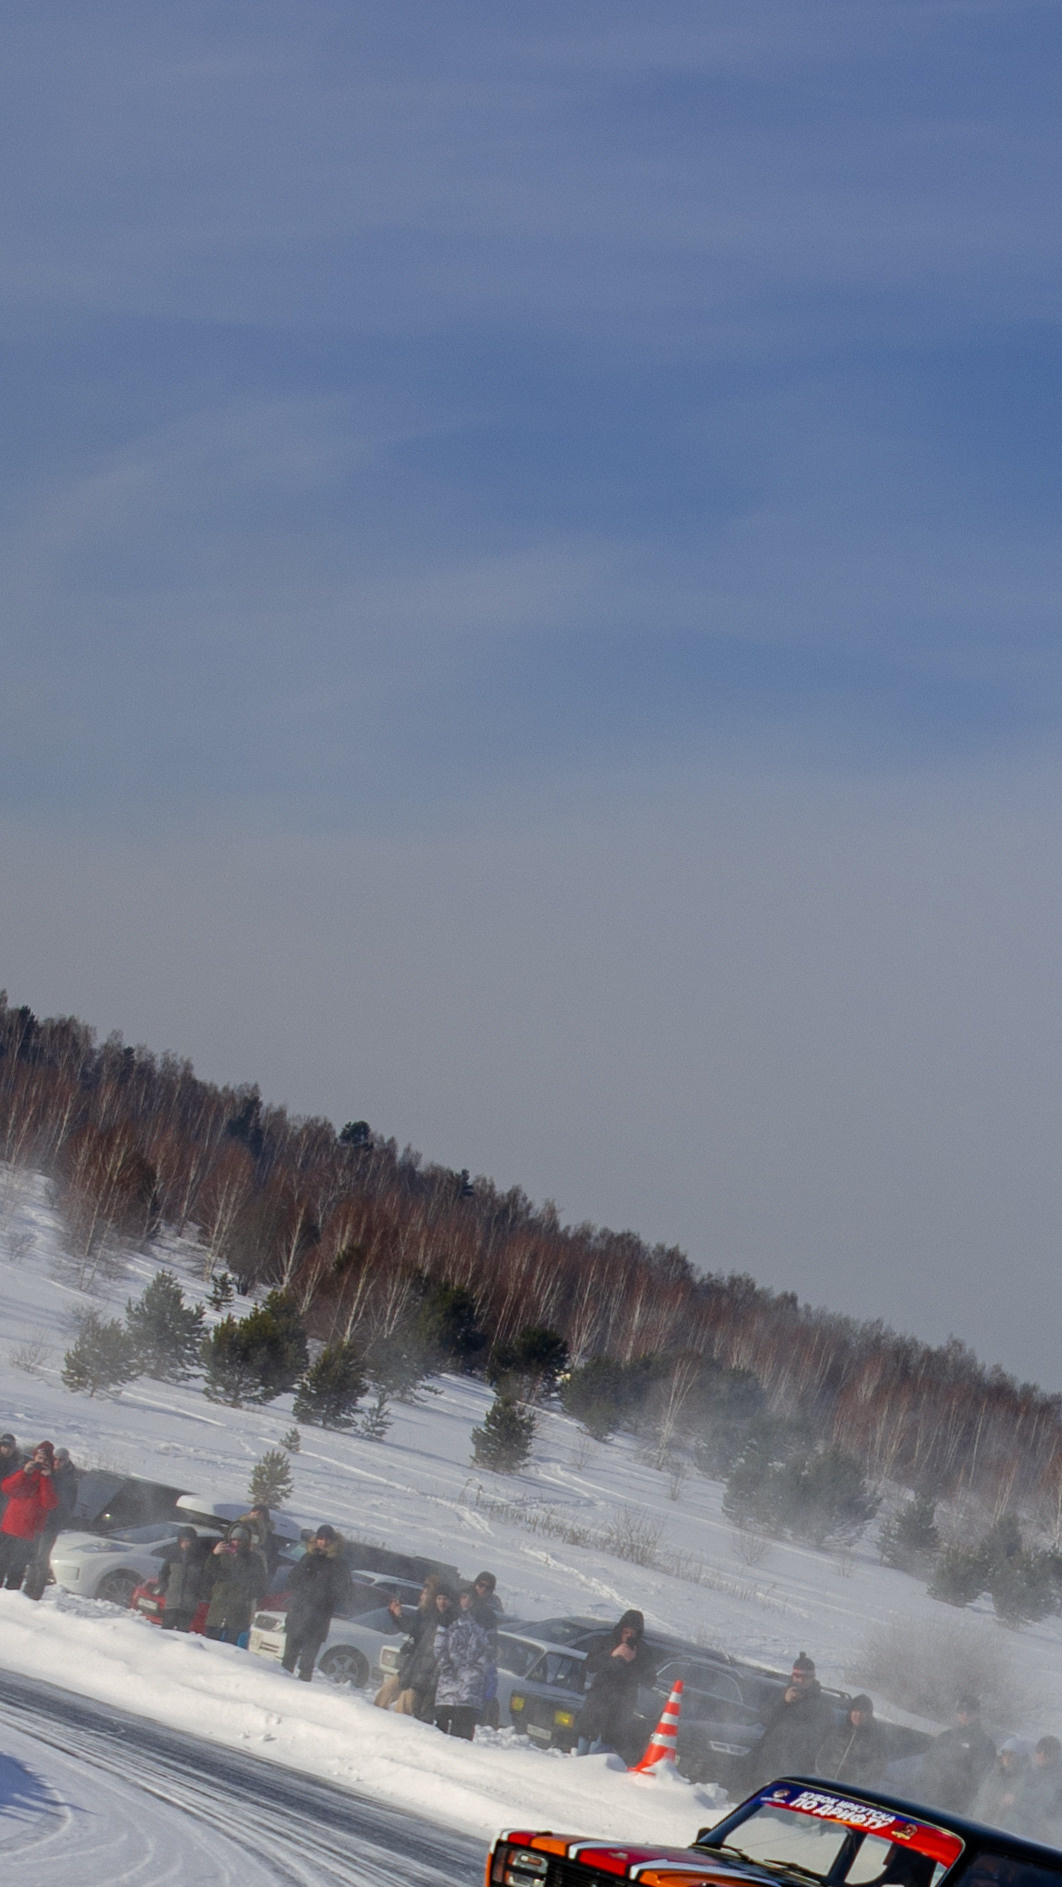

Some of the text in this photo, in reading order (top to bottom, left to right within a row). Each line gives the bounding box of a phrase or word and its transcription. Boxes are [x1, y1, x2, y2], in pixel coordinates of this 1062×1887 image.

[799, 1791, 839, 1806] КУБОК
[789, 1799, 818, 1811] ПО
[812, 1805, 892, 1830] ДРИФТУ
